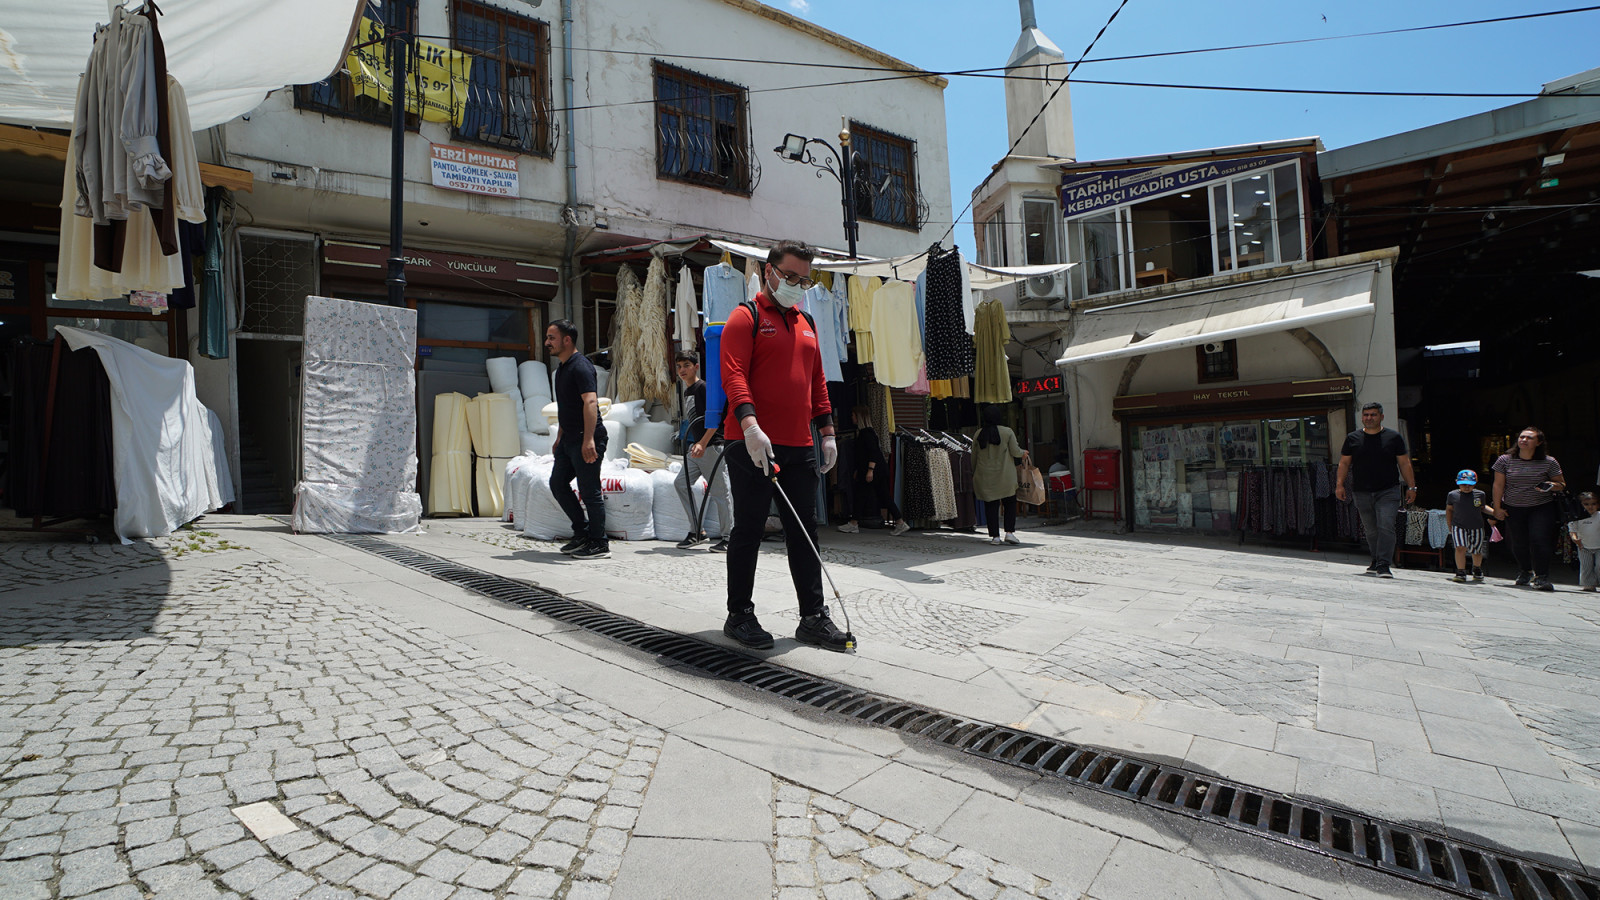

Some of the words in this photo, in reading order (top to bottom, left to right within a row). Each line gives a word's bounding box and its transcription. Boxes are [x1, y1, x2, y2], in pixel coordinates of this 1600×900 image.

[433, 80, 448, 92] 97
[432, 146, 466, 162] TERZİ
[468, 153, 517, 170] MUHTAR
[462, 165, 488, 177] GÖMLEK
[441, 171, 479, 184] TAMİRATI
[481, 178, 513, 188] YAPILIR
[449, 180, 469, 189] 0537
[471, 183, 486, 192] 770
[1068, 189, 1125, 213] KEBAPÇI
[1129, 176, 1175, 198] KADİR
[1178, 165, 1219, 184] USTA
[1217, 388, 1250, 399] TEKSTİL
